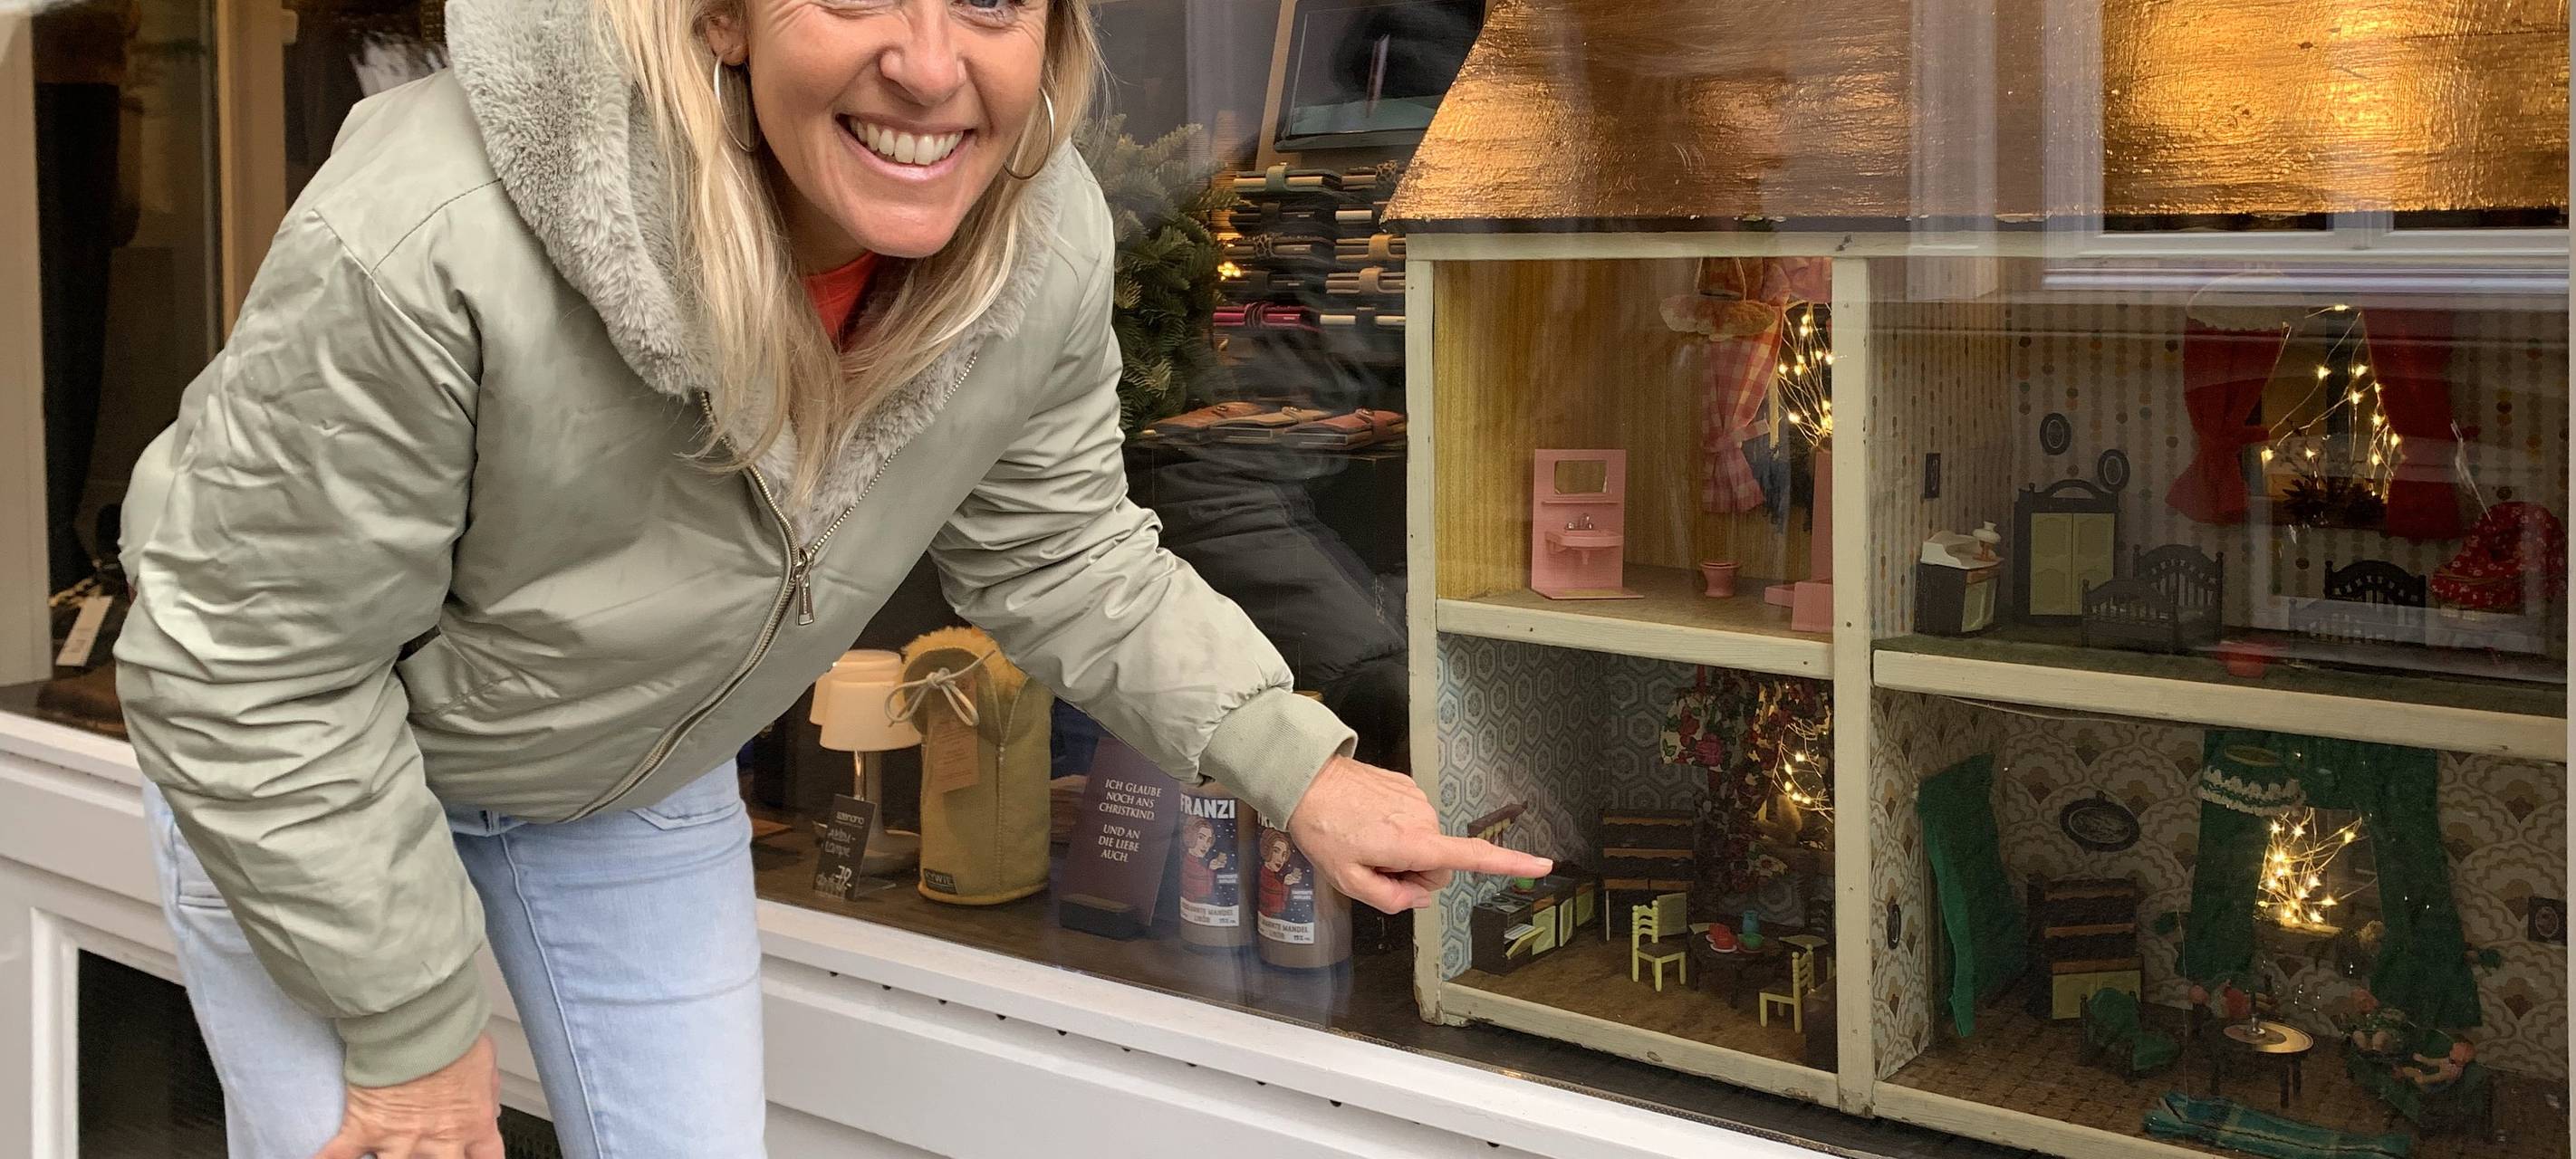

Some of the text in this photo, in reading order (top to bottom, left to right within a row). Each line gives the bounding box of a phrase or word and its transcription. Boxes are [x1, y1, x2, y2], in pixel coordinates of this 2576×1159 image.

[1105, 779, 1162, 798] ICH GLAUBE
[1106, 791, 1155, 809] NOCH ANS
[1180, 792, 1235, 819] FRANZI
[1103, 824, 1141, 839] UND AN
[1098, 836, 1140, 852] DIE LIEBE
[1282, 924, 1308, 934] MANDEL
